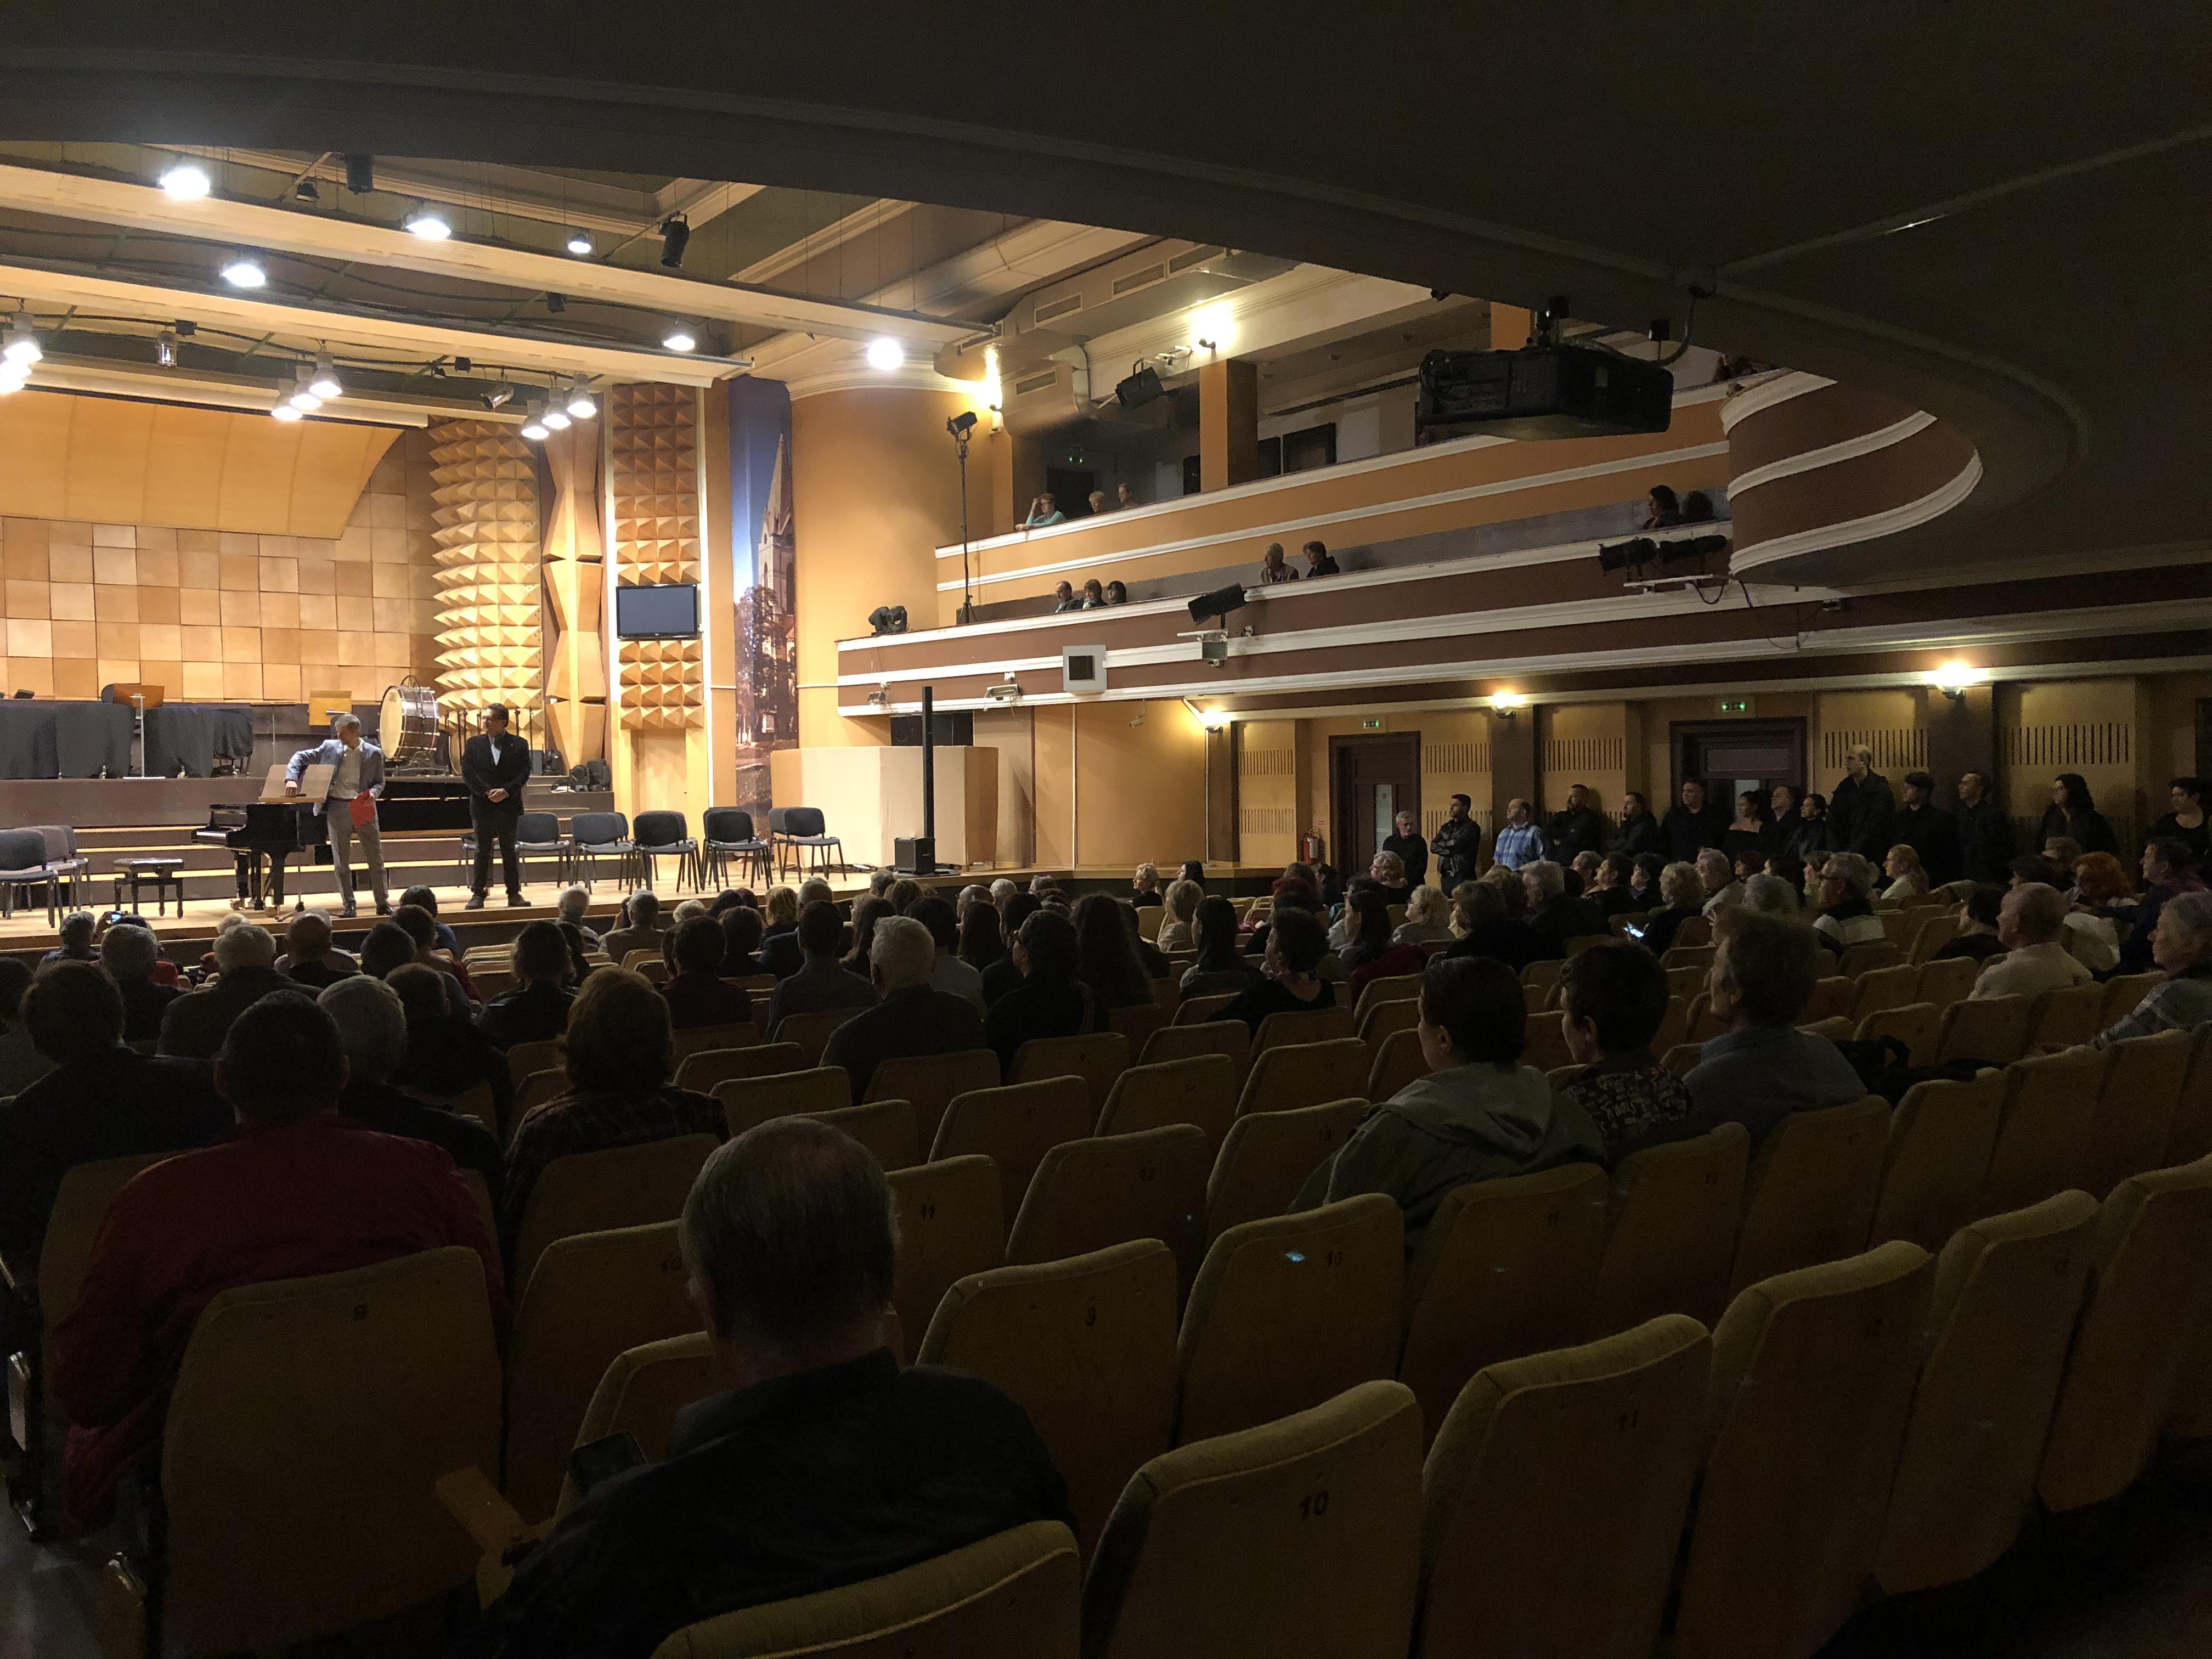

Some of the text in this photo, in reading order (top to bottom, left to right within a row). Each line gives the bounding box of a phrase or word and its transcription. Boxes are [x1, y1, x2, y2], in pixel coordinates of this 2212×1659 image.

[1140, 1166, 1156, 1181] 12
[920, 1204, 935, 1220] 11
[661, 1256, 683, 1273] 10
[1325, 1251, 1342, 1267] 10
[1085, 1307, 1096, 1326] 9
[1617, 1408, 1639, 1433] 11
[1299, 1490, 1329, 1520] 10
